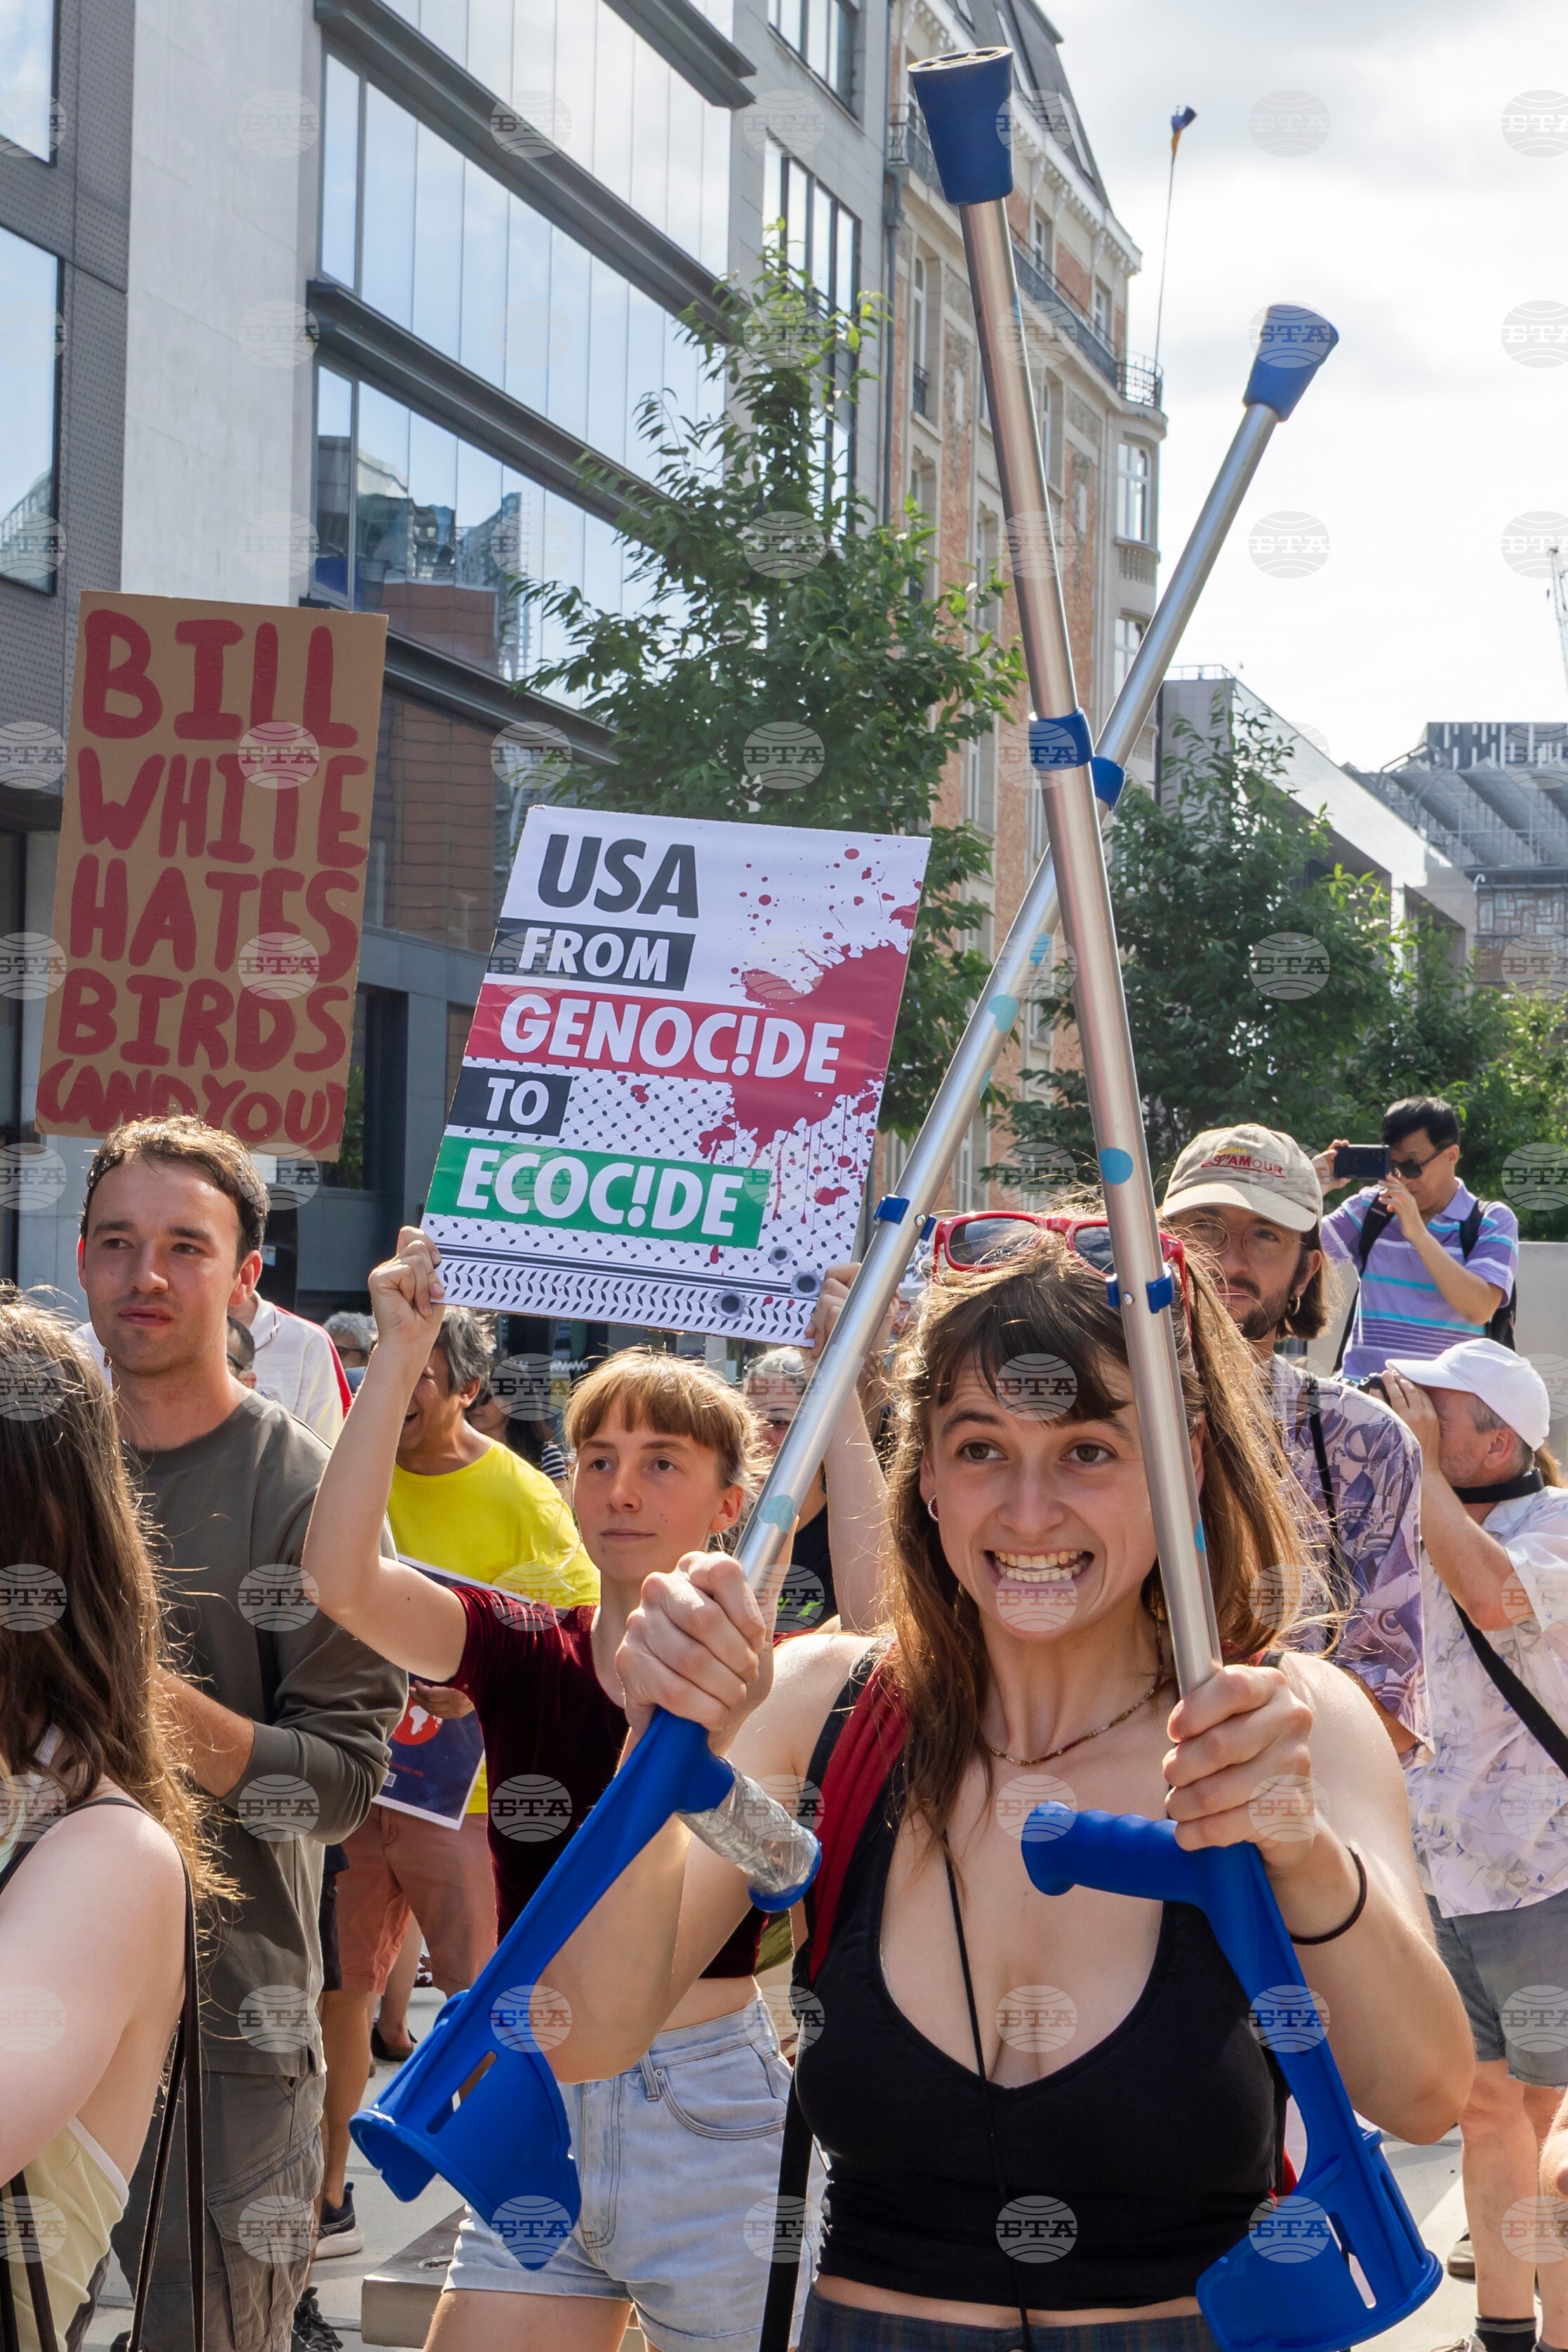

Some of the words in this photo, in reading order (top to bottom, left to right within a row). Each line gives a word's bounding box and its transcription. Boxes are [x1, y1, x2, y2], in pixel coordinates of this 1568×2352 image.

[83, 609, 358, 747] BILL
[79, 747, 368, 868] WHITE
[70, 853, 359, 983] HATES
[538, 834, 699, 919] USA
[519, 927, 672, 983] FROM
[58, 969, 348, 1072] BIRDS
[500, 993, 845, 1084] GENOC!DE
[486, 1077, 550, 1127] TO
[456, 1147, 744, 1237] ECOC!DE
